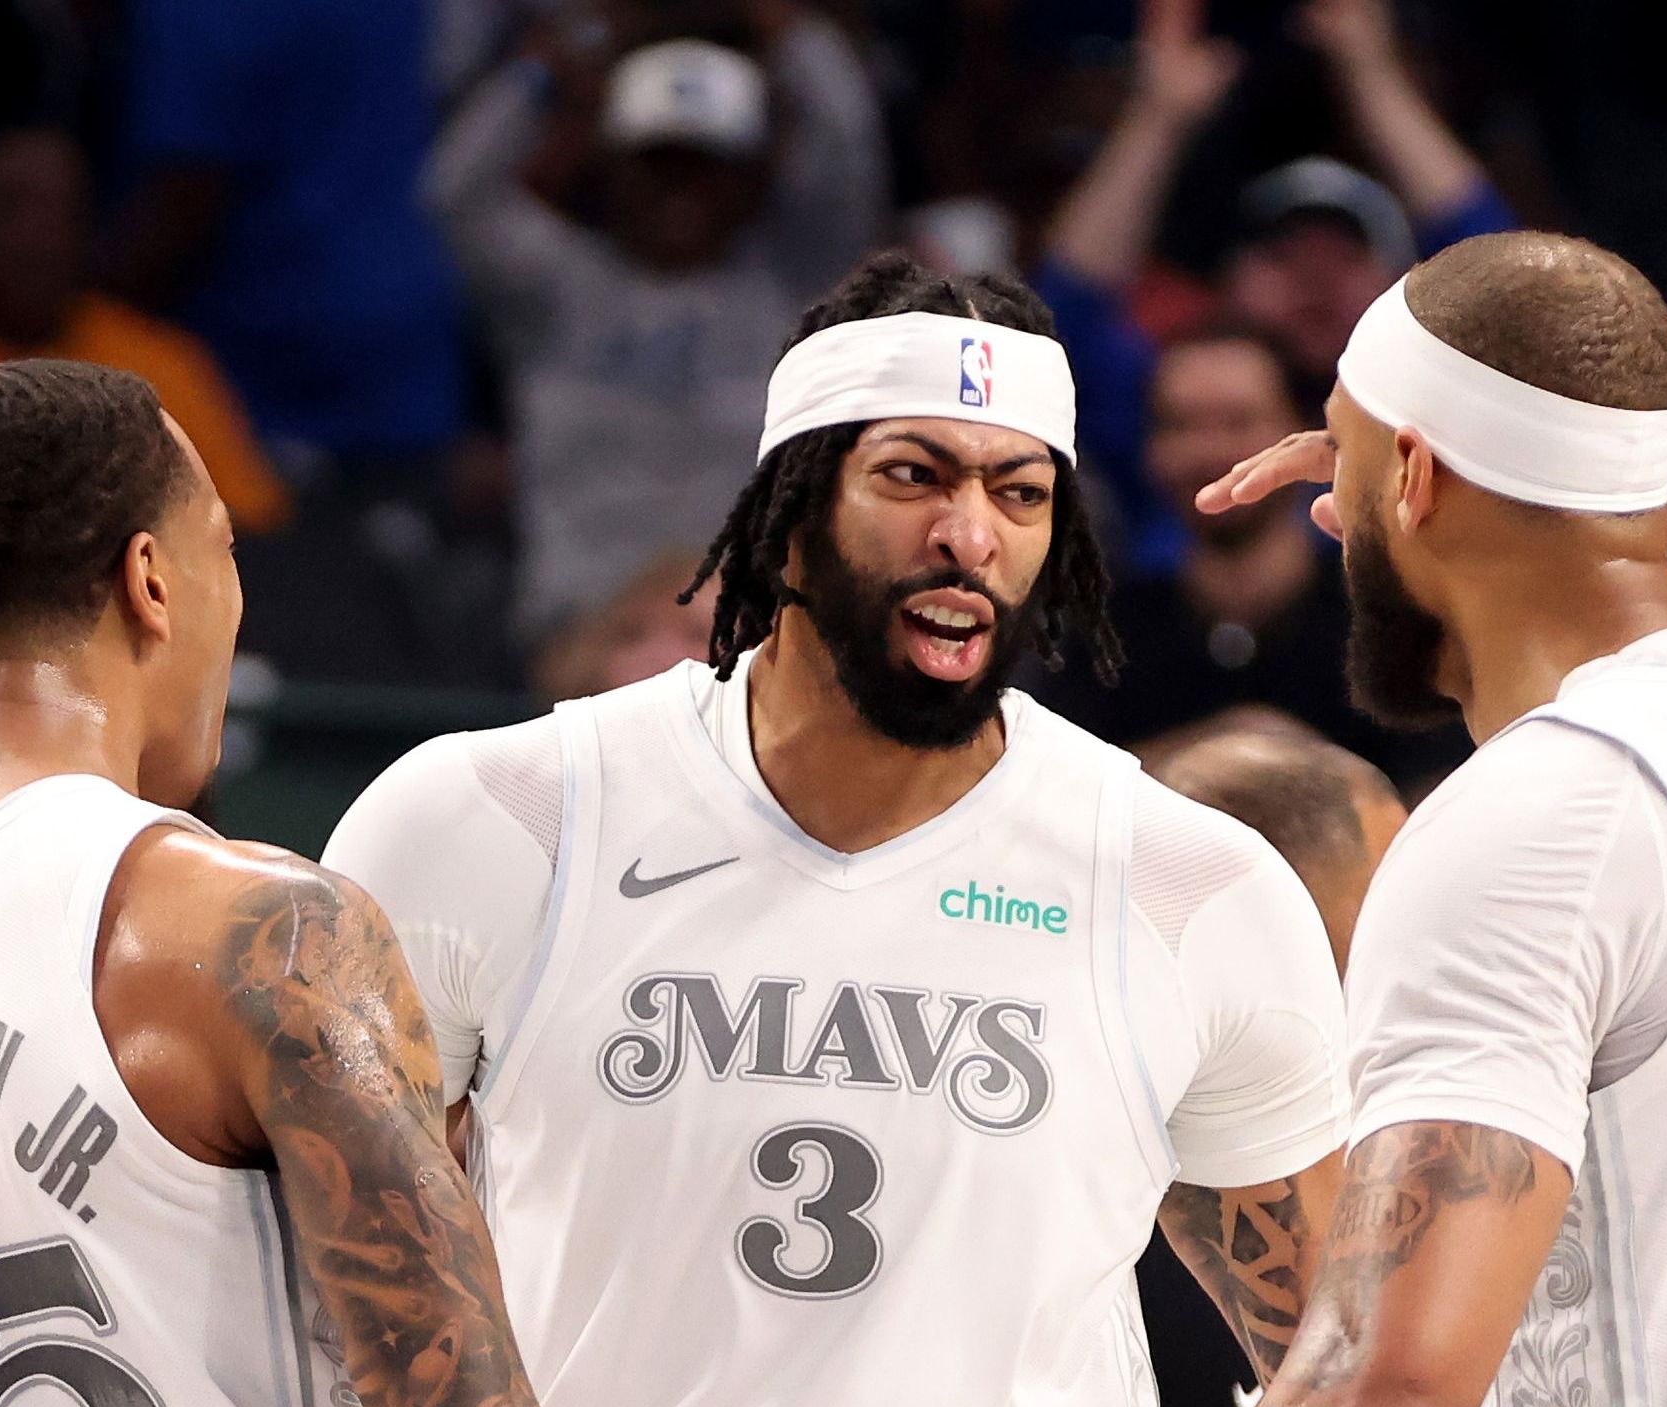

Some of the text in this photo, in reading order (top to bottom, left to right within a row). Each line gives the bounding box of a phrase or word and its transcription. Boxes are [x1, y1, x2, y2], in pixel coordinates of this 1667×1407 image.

[939, 879, 1068, 934] chime
[596, 971, 1054, 1137] MAVS
[14, 1083, 119, 1225] JR.
[734, 1119, 884, 1301] 3
